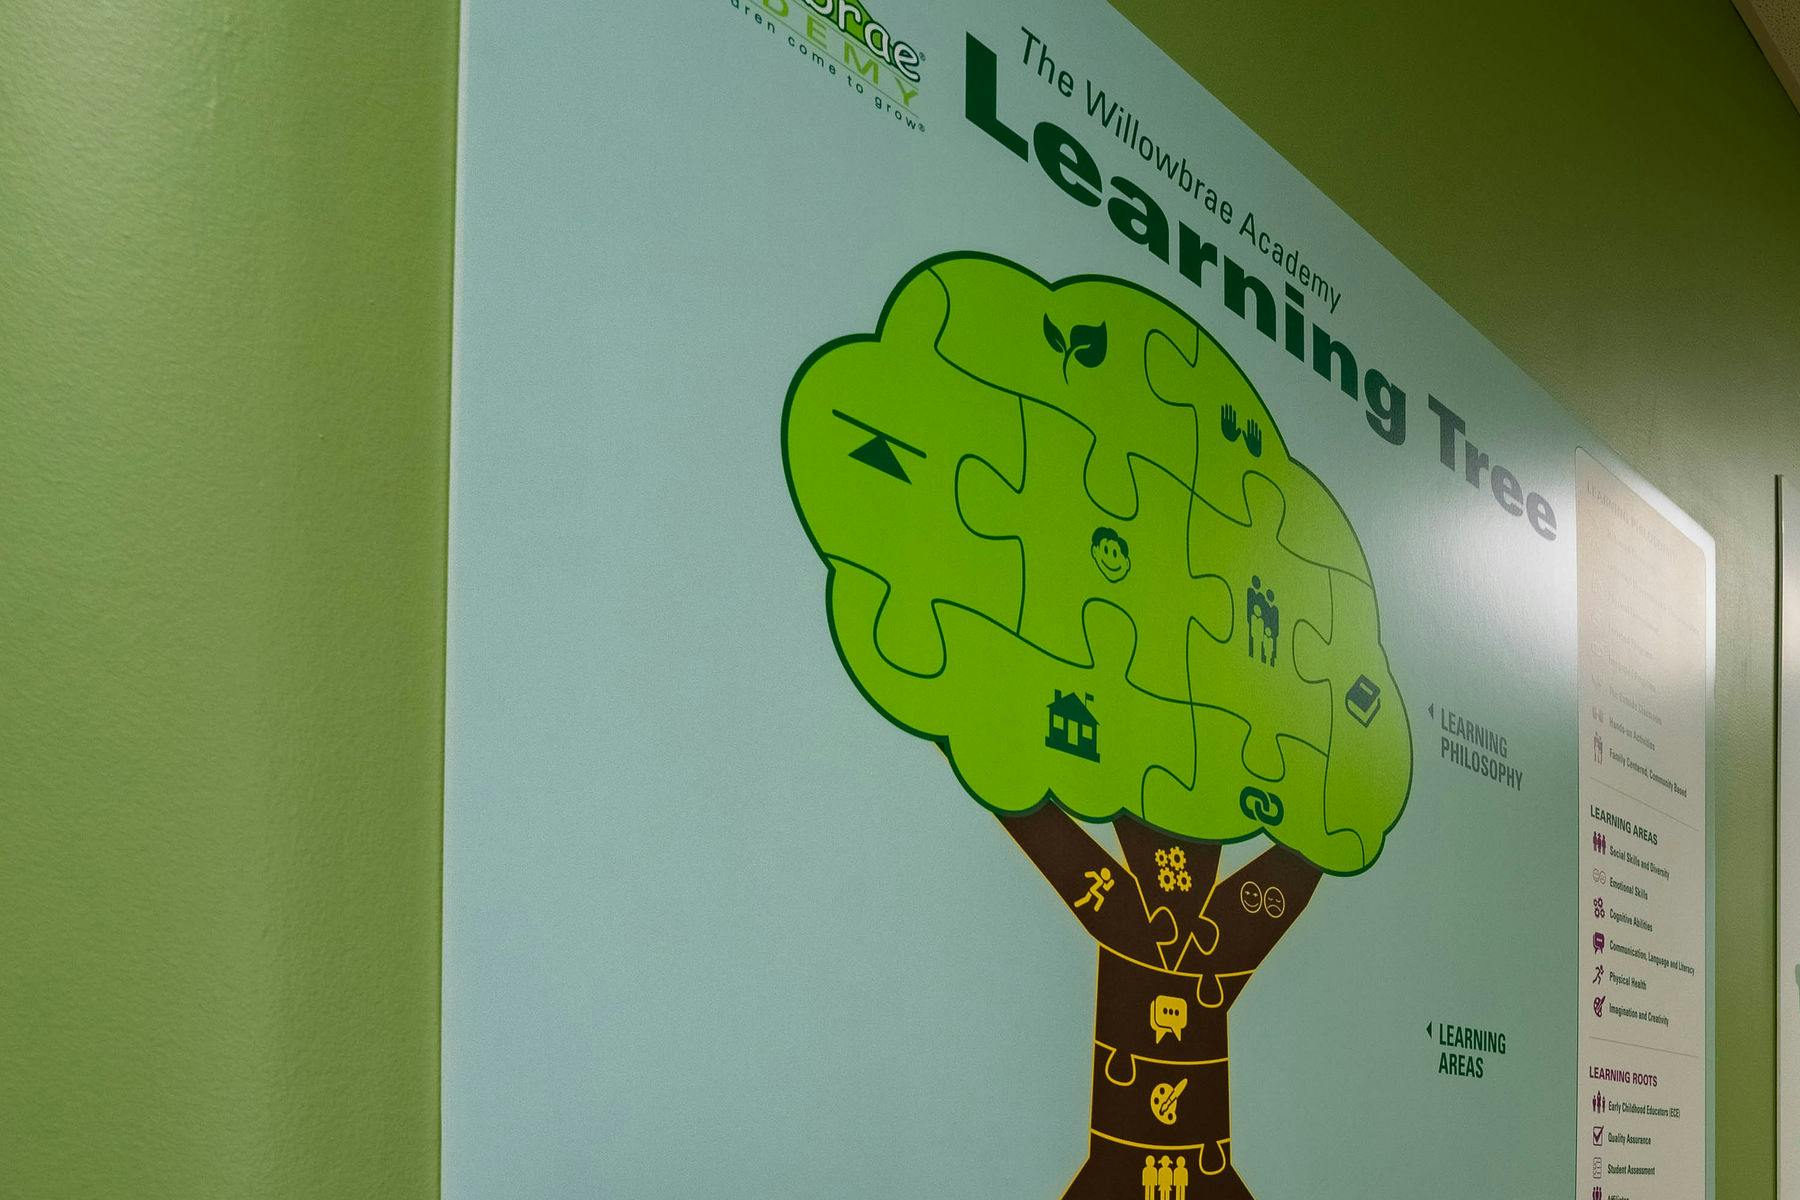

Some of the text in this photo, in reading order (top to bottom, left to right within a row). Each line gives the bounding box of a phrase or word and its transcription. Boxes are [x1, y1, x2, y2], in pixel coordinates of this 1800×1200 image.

[788, 36, 836, 75] come
[848, 75, 864, 94] to
[1020, 27, 1341, 313] The Willowbrae Academy
[965, 31, 1557, 541] Learning Tree
[1441, 708, 1508, 758] LEARNING
[1441, 741, 1523, 791] PHILOSOPHY
[1610, 747, 1626, 767] Family
[1649, 768, 1674, 792] Community
[1590, 805, 1657, 845] LEARNING AREAS
[1610, 846, 1670, 880] Social Skills and Diversity
[1610, 877, 1648, 900] Emotional Skills
[1610, 908, 1653, 932] Cognitive Abilities
[1610, 940, 1695, 977] Communication, Language and Literacy
[1609, 971, 1647, 990] Physical Health
[1609, 1003, 1669, 1028] Imagination and Creativity
[1439, 1023, 1506, 1055] LEARNING
[1439, 1051, 1484, 1078] AREAS
[1589, 1066, 1657, 1087] LEARNING ROOTS
[1608, 1100, 1680, 1119] Early Childhood Educators (ECE)
[1608, 1133, 1651, 1146] Quality Assurance
[1608, 1164, 1655, 1176] Student Assessment
